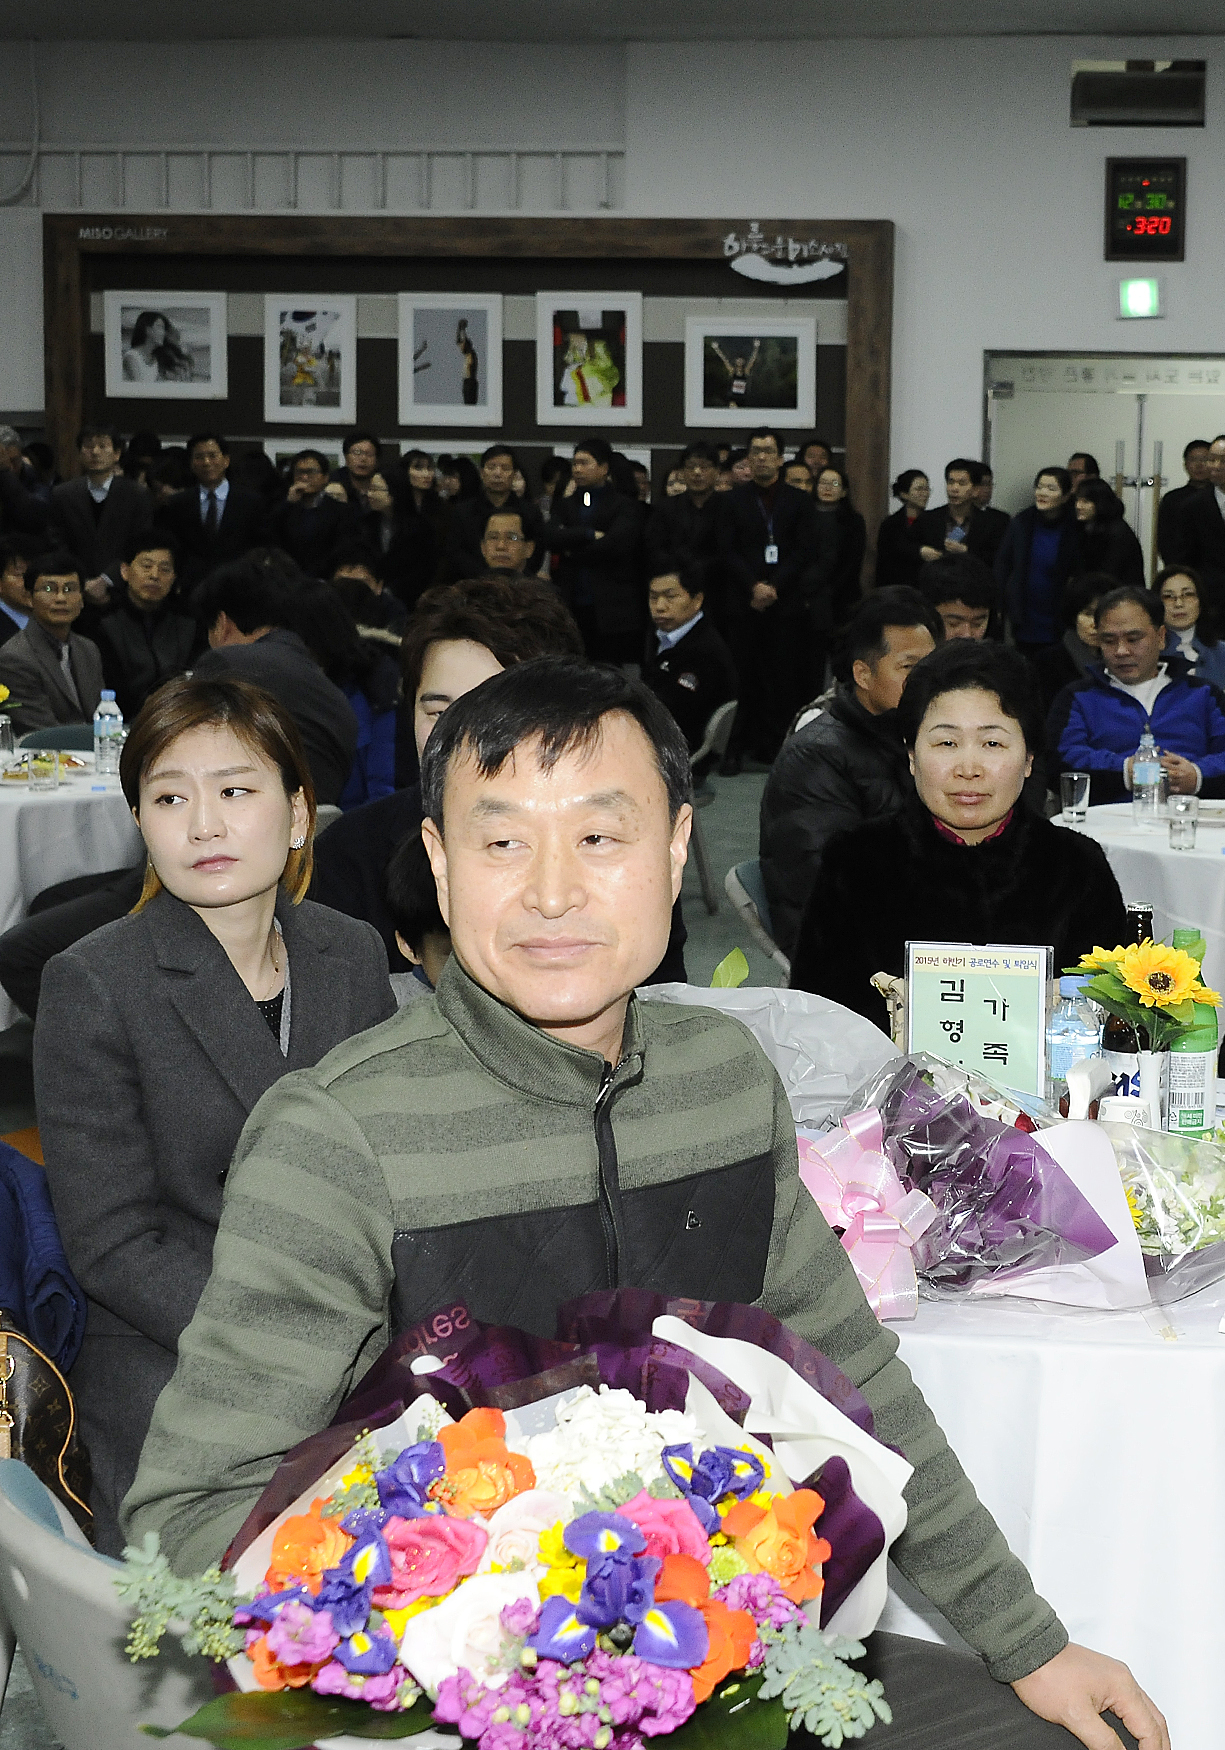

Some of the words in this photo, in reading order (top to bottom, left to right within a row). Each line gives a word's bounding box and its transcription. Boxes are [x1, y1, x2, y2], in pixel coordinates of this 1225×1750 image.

[915, 956, 940, 967] 2015년
[942, 956, 966, 968] 하반기
[968, 957, 1000, 969] 공로연수
[1002, 959, 1011, 970] 및
[1013, 960, 1038, 971] 퇴임식
[983, 998, 1010, 1066] 가족
